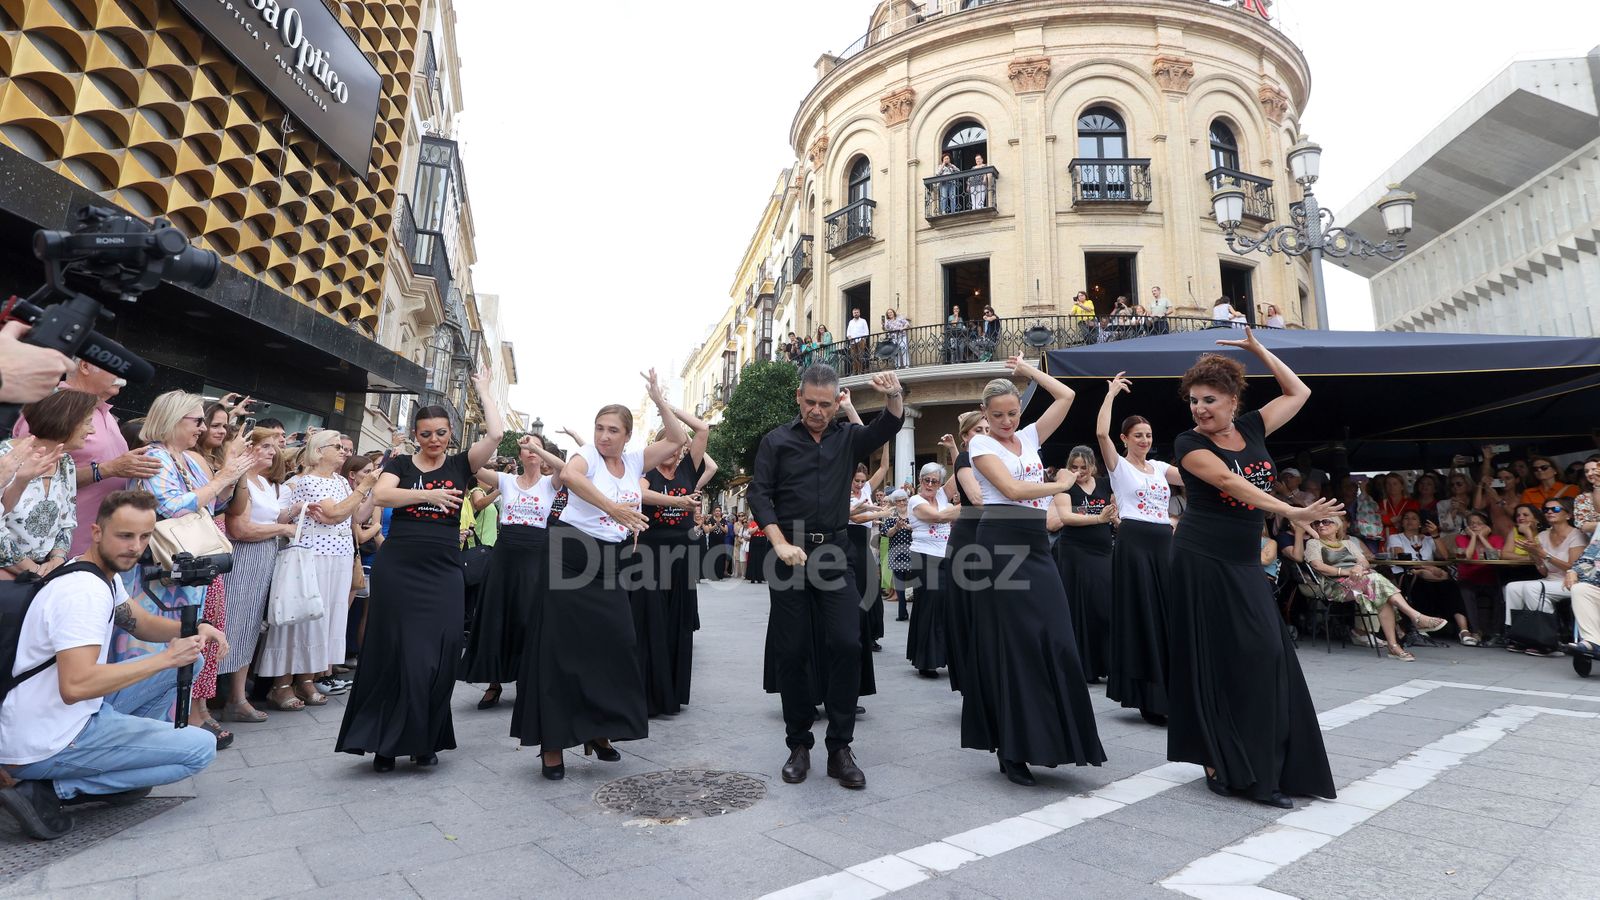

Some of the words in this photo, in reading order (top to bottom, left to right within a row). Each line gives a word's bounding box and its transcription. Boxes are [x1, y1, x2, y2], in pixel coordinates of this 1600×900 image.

[264, 41, 271, 50] Y
[283, 7, 348, 104] Optico
[96, 237, 125, 245] RONIN
